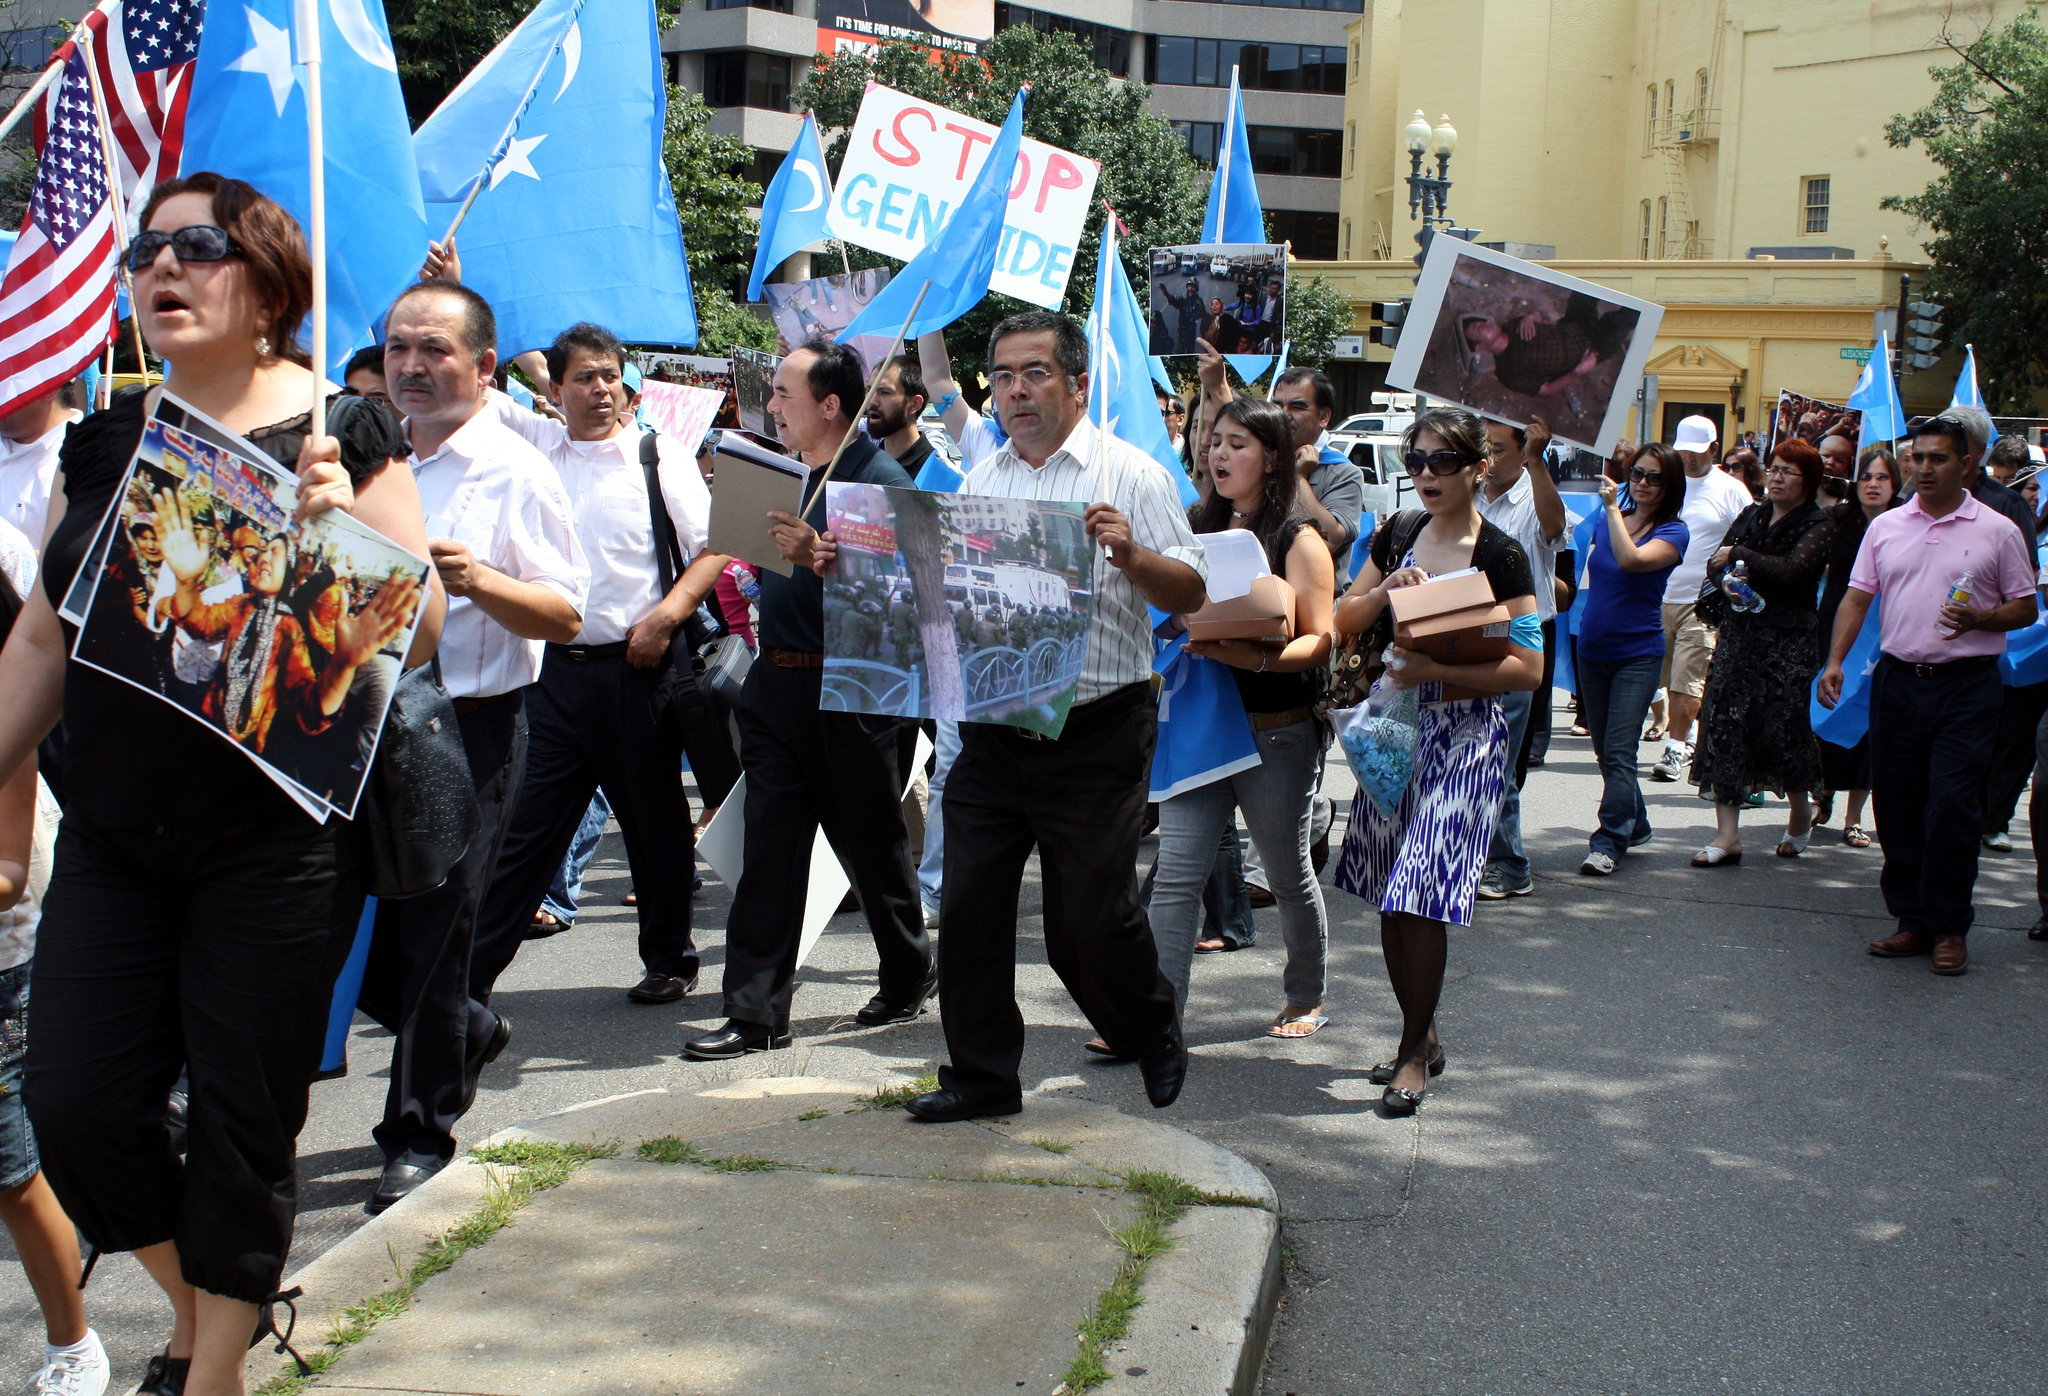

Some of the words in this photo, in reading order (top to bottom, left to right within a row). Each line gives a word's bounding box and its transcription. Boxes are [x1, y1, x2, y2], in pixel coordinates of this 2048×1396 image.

[836, 16, 852, 30] IT'S
[853, 19, 873, 33] TIME
[874, 23, 890, 36] FOR
[932, 35, 941, 47] TO
[963, 41, 977, 54] THE
[841, 173, 1072, 290] GENIDE
